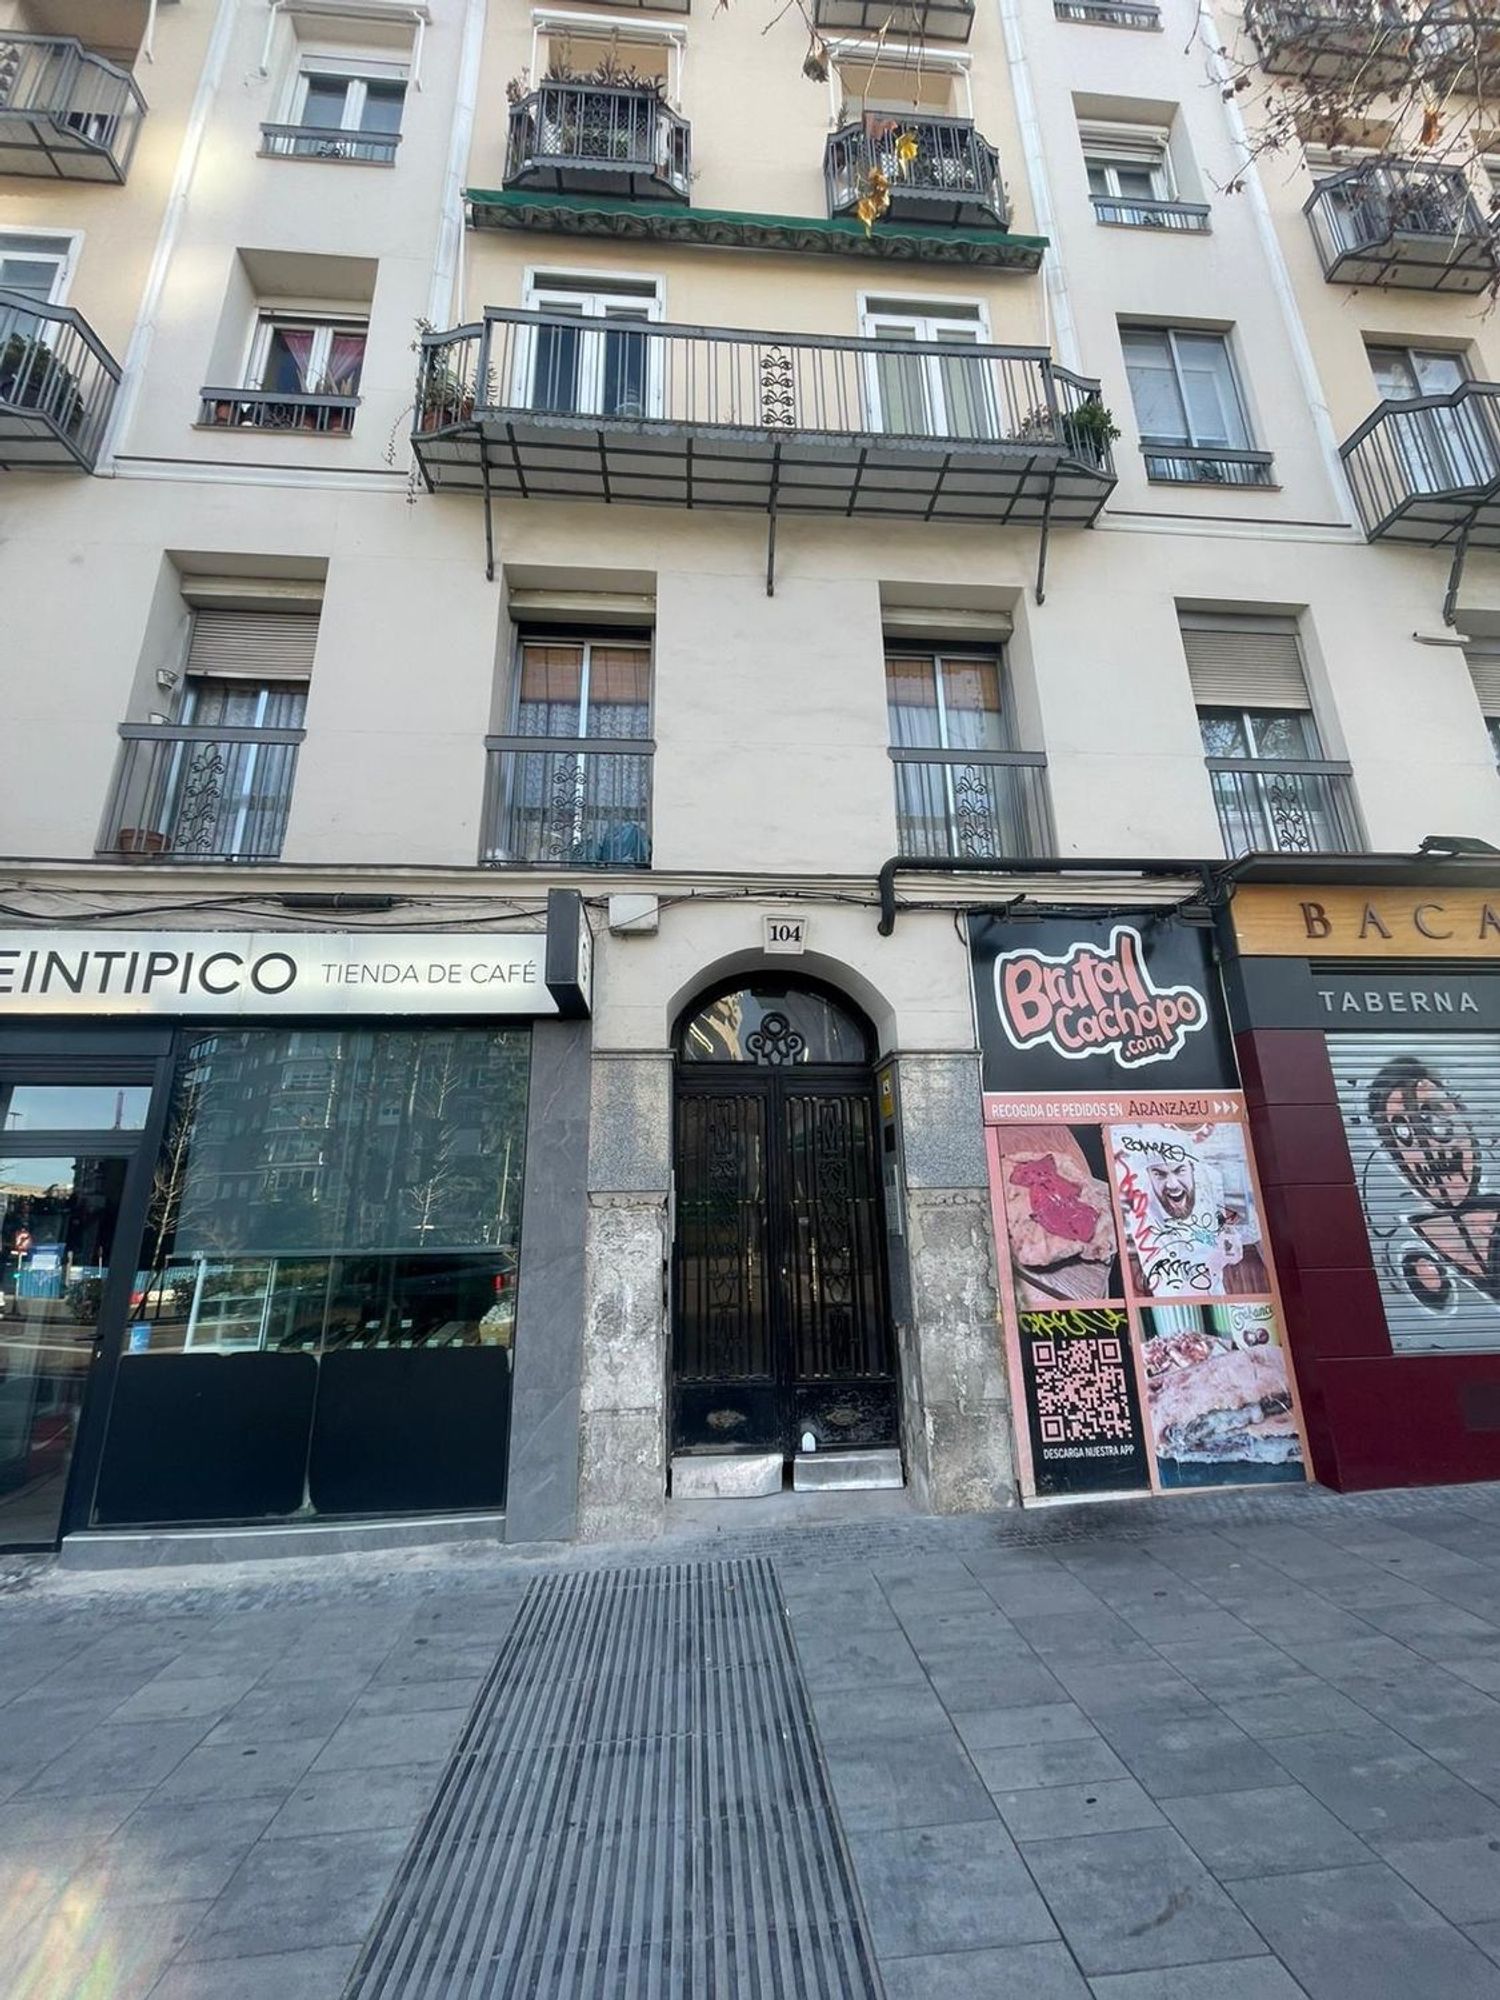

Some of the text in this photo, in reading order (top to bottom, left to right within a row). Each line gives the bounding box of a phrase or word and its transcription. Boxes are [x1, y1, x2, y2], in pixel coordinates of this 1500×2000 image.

[770, 925, 802, 942] 104
[321, 960, 537, 984] TIENDA DE CAFÉ
[1005, 935, 1149, 1039] Brutal
[1318, 991, 1479, 1013] TABERNA
[1055, 994, 1197, 1048] Cachopo
[1124, 1033, 1165, 1058] .com
[991, 1103, 1044, 1118] RECOGIDA
[1045, 1103, 1060, 1117] DE
[1061, 1102, 1108, 1117] PEDIDOS
[1109, 1102, 1124, 1116] EN
[1043, 1444, 1135, 1460] DESCARGA NUESTRA APP
